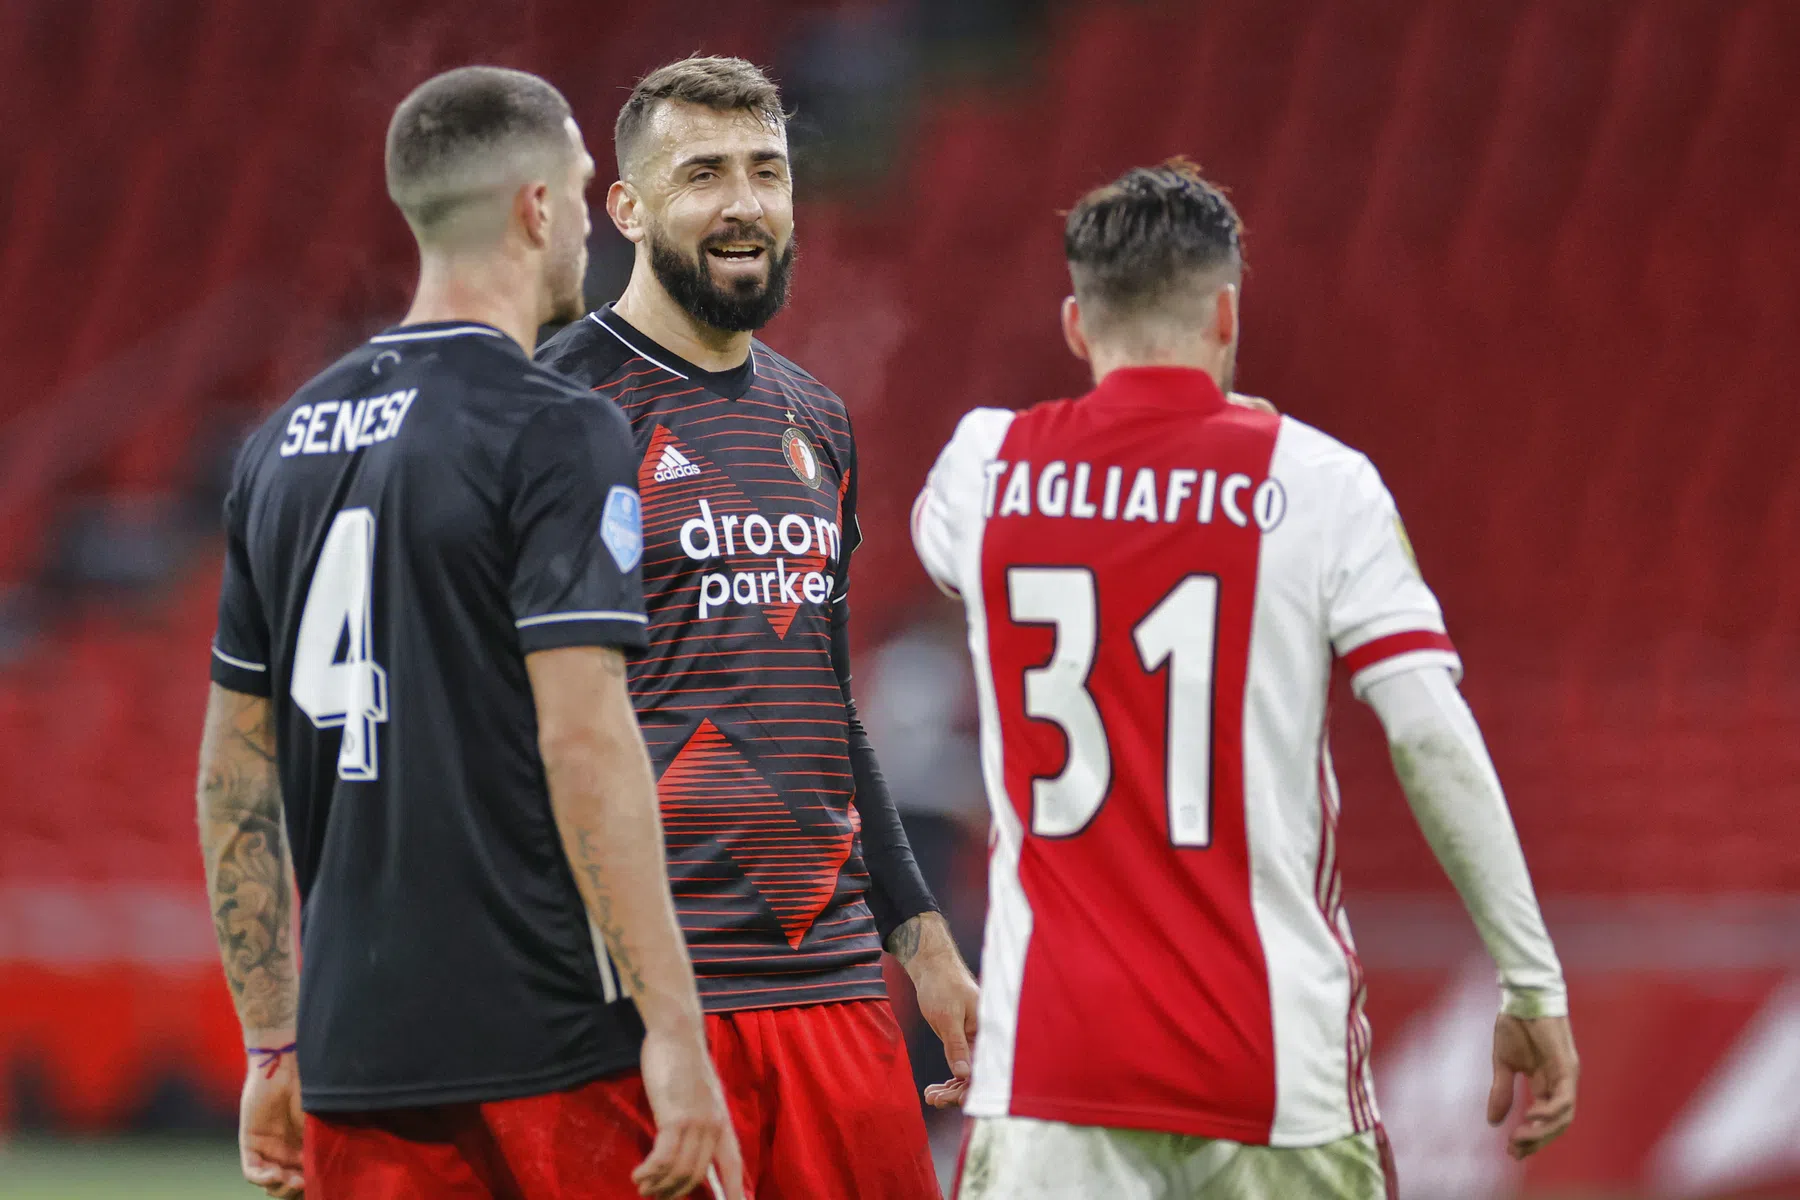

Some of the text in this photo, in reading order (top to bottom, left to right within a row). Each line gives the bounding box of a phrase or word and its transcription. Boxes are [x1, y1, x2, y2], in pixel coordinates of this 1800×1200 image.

[280, 387, 419, 458] SENESI
[653, 464, 701, 483] adidas
[983, 460, 1287, 532] TAGLIAFICO
[679, 499, 841, 564] droom
[291, 507, 388, 780] 4
[1006, 565, 1220, 849] 31
